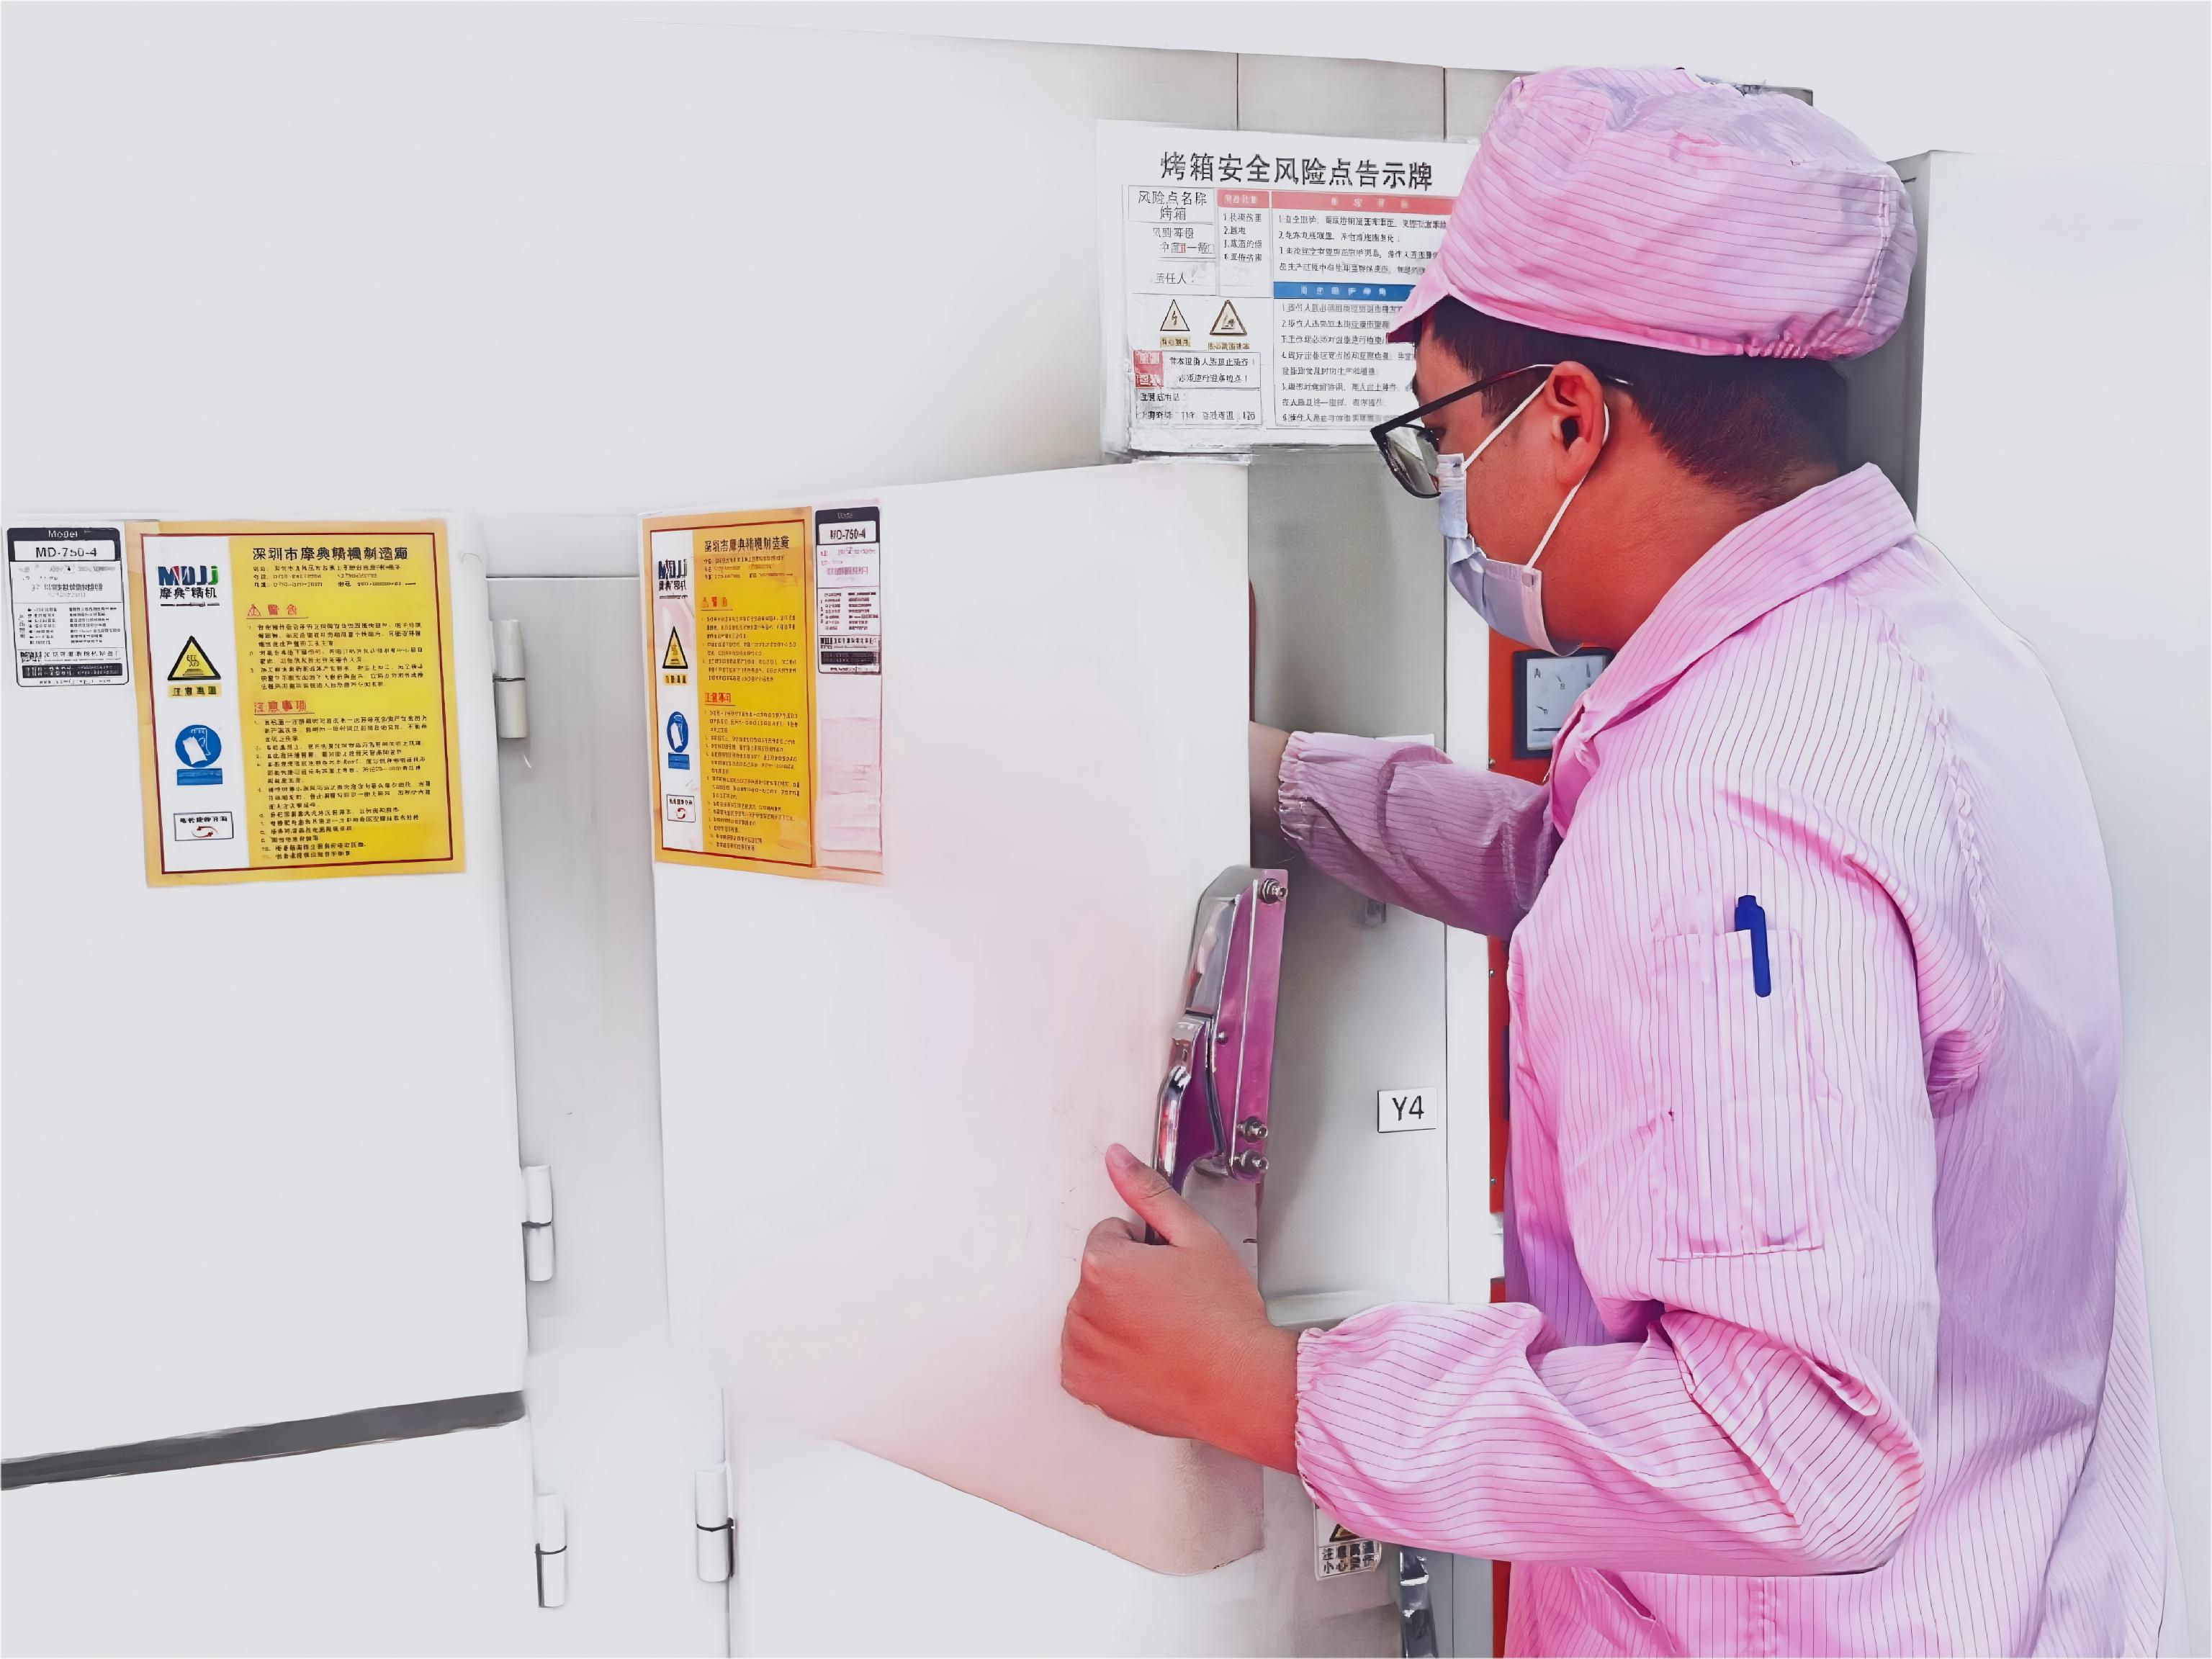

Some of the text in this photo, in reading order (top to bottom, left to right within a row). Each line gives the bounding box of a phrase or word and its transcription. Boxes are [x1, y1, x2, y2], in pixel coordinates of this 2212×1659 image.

[1160, 150, 1433, 192] 烤箱安全风险点告示牌
[1390, 1094, 1425, 1121] Y4
